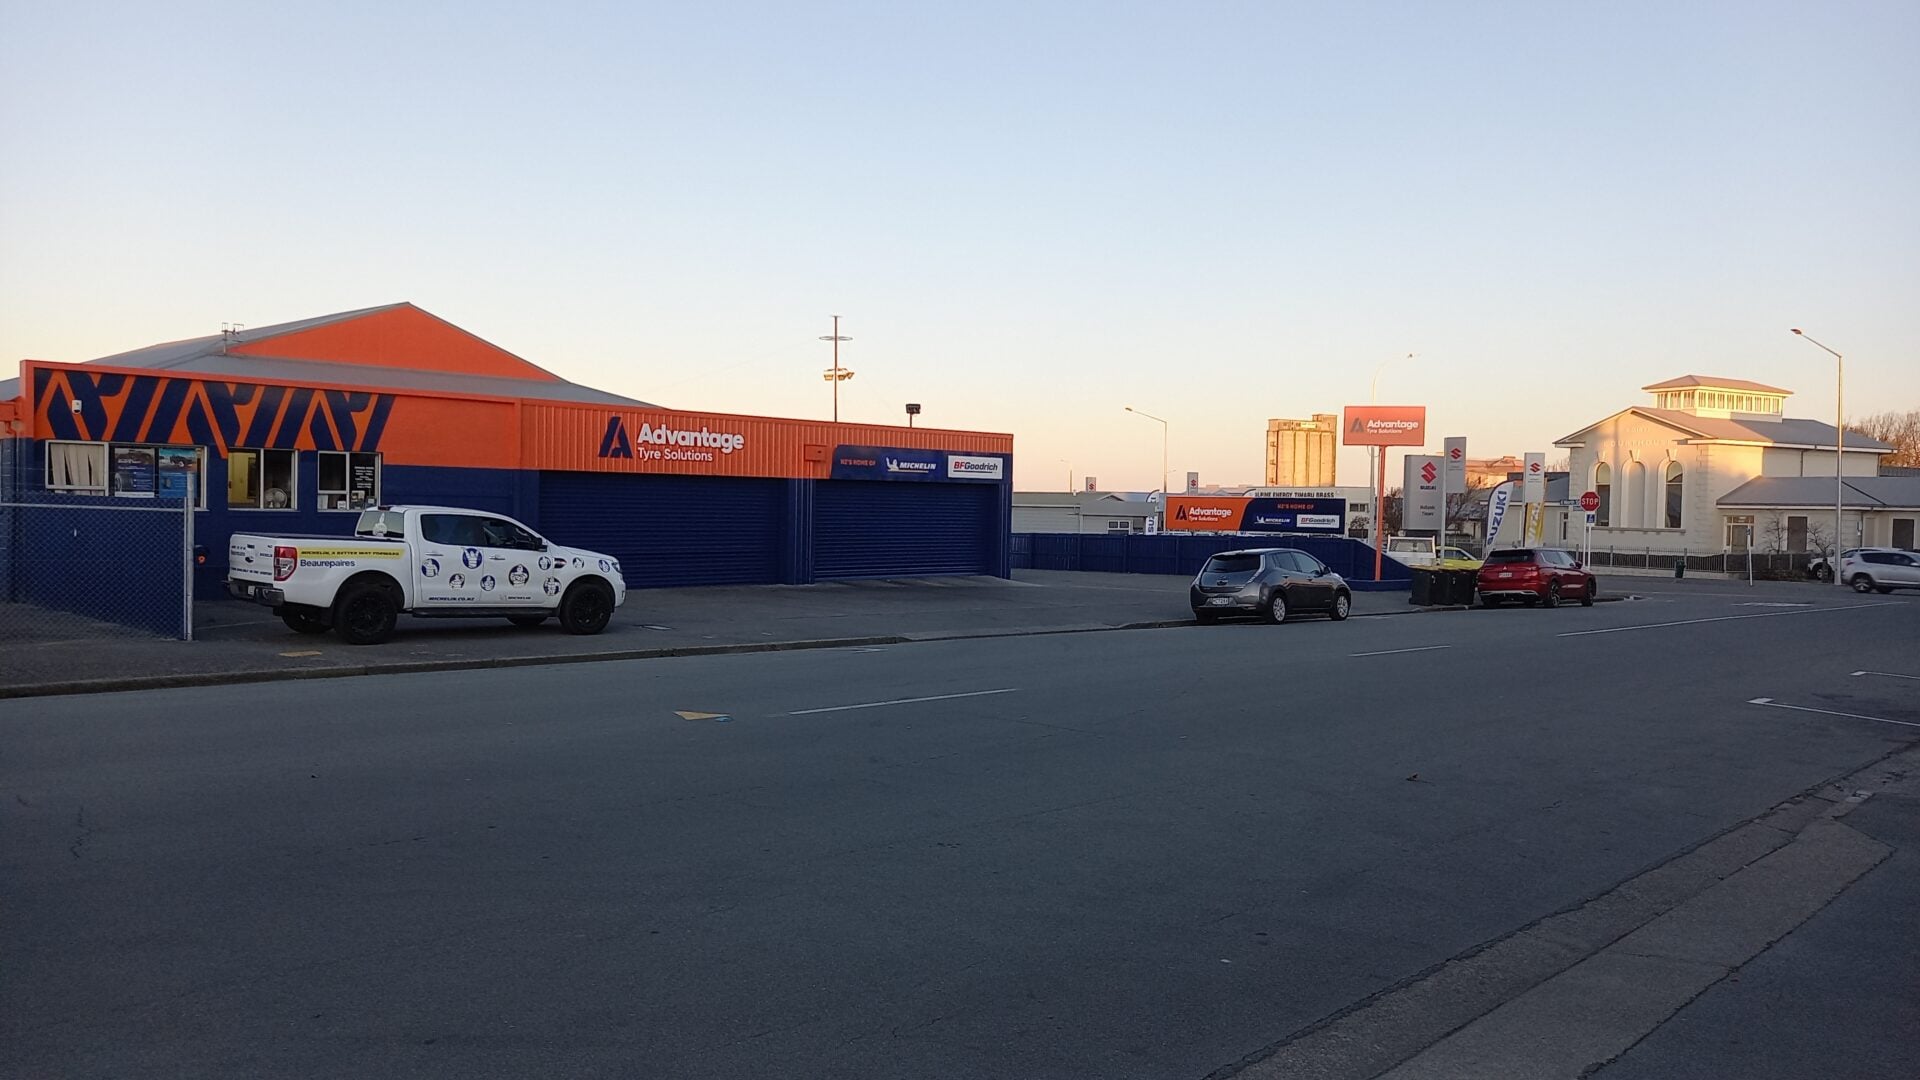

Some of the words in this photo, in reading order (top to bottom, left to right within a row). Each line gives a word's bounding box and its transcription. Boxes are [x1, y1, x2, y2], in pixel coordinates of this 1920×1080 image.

[1367, 420, 1418, 430] Advantage
[637, 423, 745, 454] Advantage
[638, 447, 661, 461] Tyre
[664, 448, 713, 462] Solutions
[899, 462, 936, 470] MICHELIN
[953, 461, 998, 471] BFGoodrich
[1189, 507, 1232, 518] Advantage
[1487, 490, 1507, 546] SUZUKI
[300, 559, 355, 568] Beaurepaires
